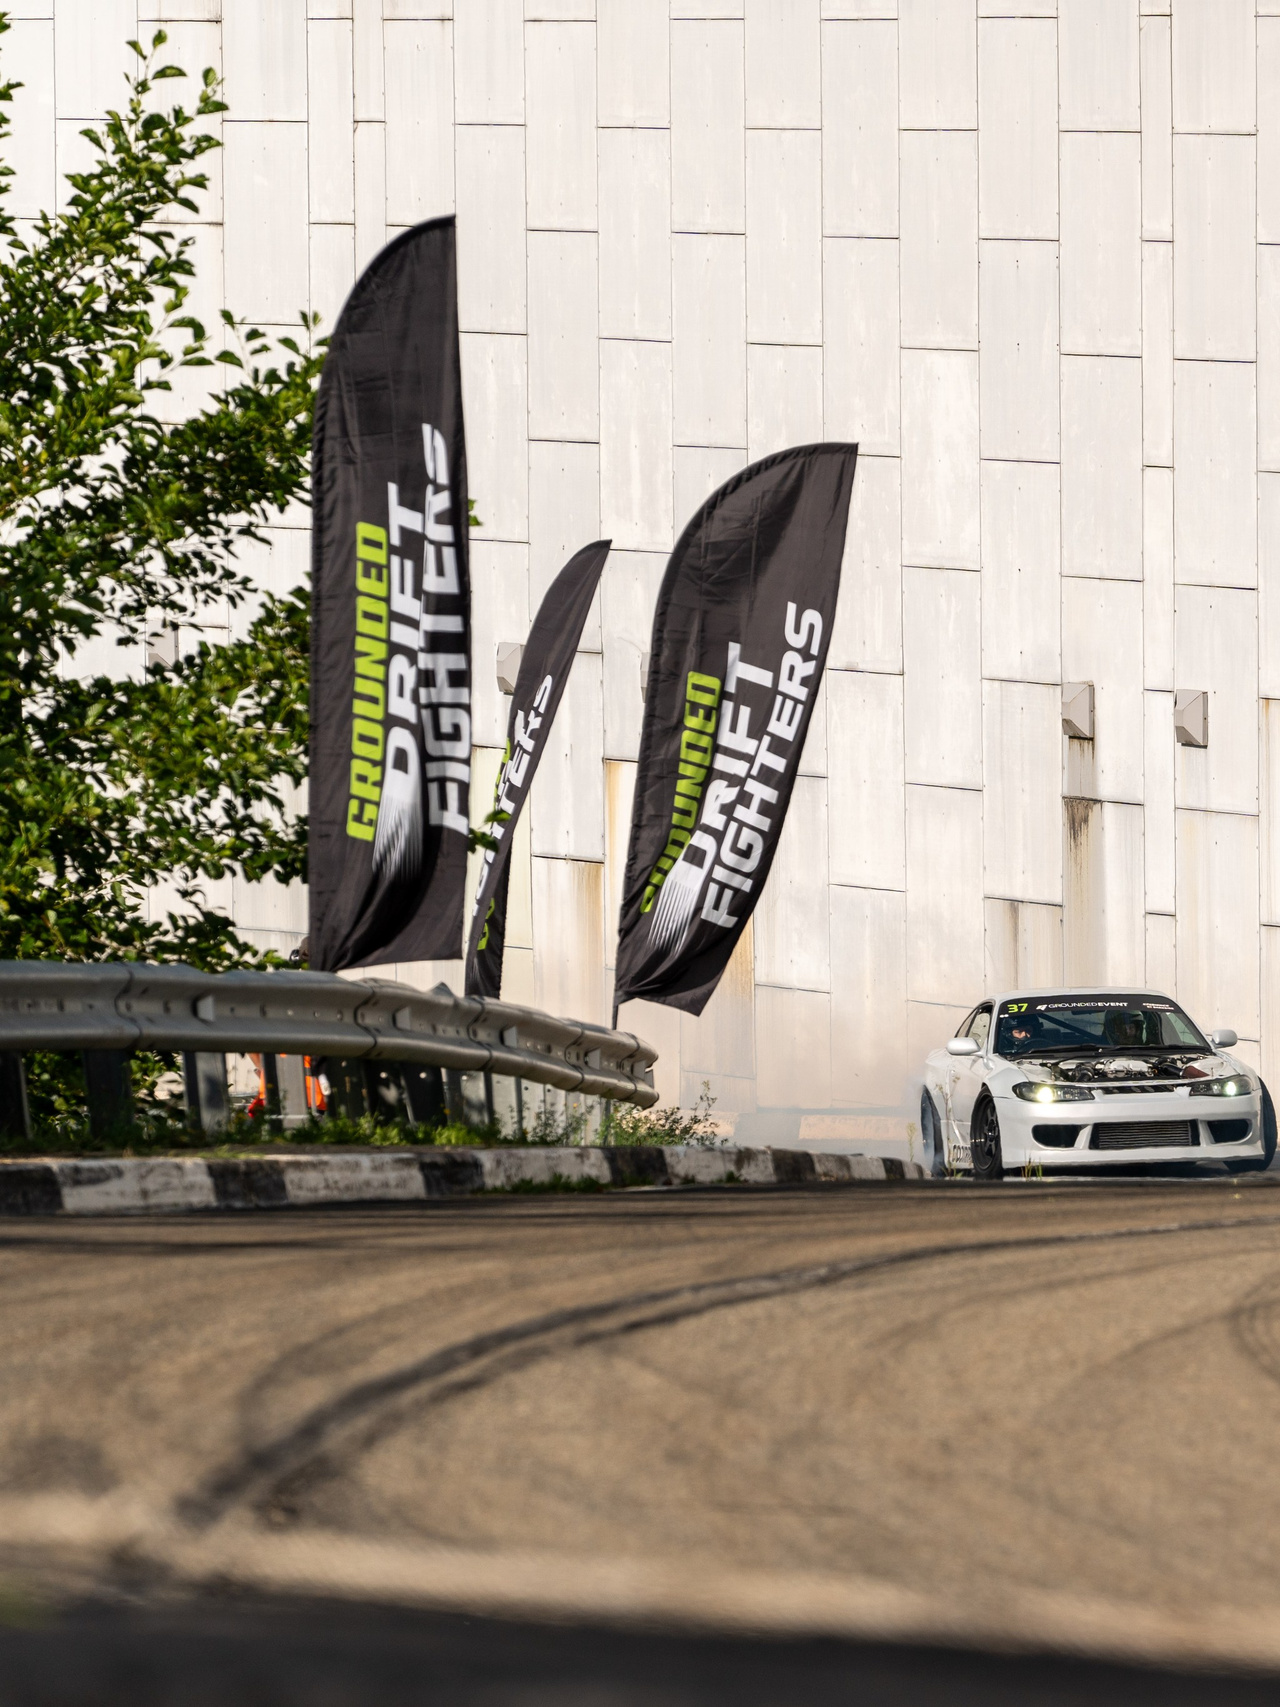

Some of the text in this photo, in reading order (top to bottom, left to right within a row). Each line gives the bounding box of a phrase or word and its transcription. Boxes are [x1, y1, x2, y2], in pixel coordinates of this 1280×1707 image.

[346, 520, 388, 842] GROUNDED
[377, 481, 424, 845] DRIFT
[418, 422, 470, 836] FIGHTERS
[655, 641, 774, 925] DRIFT
[700, 601, 823, 929] FIGHTERS
[1007, 1003, 1028, 1013] 37
